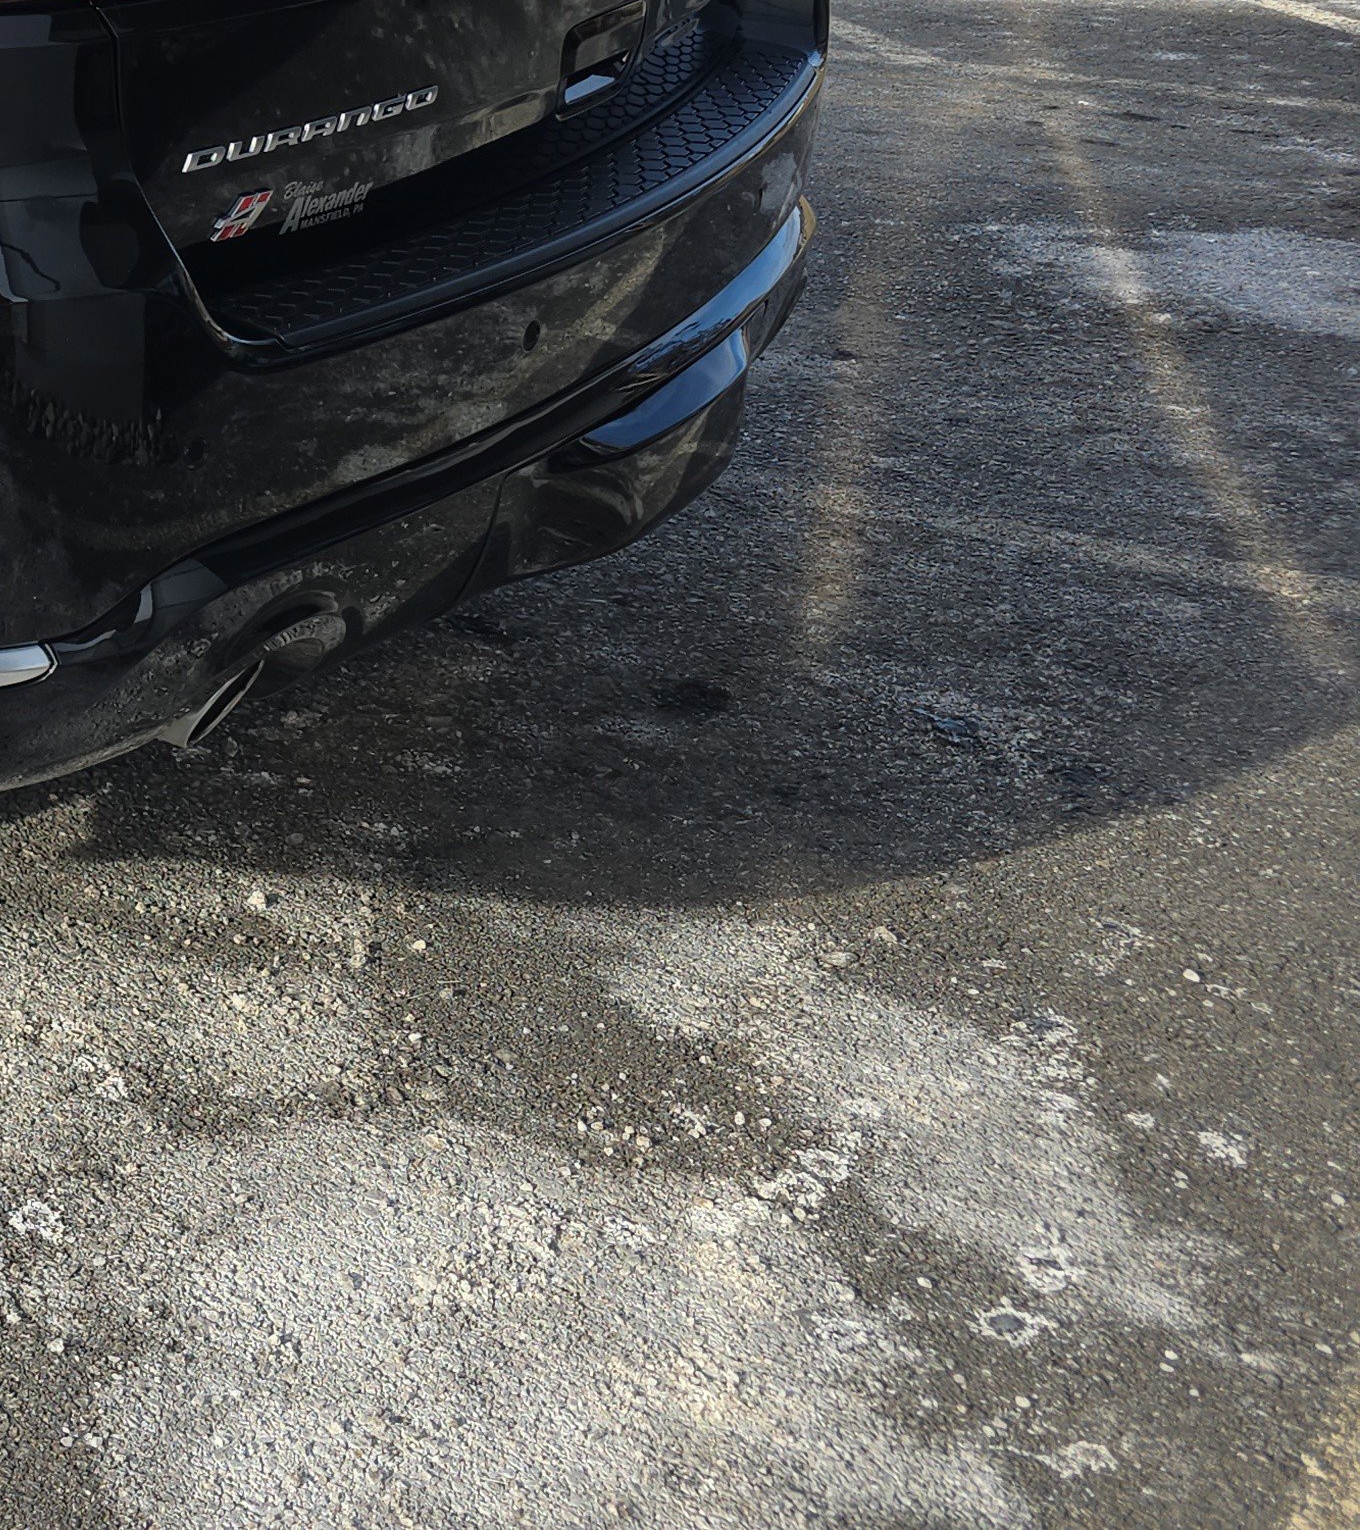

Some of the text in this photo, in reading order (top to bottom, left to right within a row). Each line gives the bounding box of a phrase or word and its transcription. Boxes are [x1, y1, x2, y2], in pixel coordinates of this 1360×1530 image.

[181, 85, 439, 174] DURANGO
[279, 181, 374, 236] Alexander
[283, 181, 324, 200] Blaise
